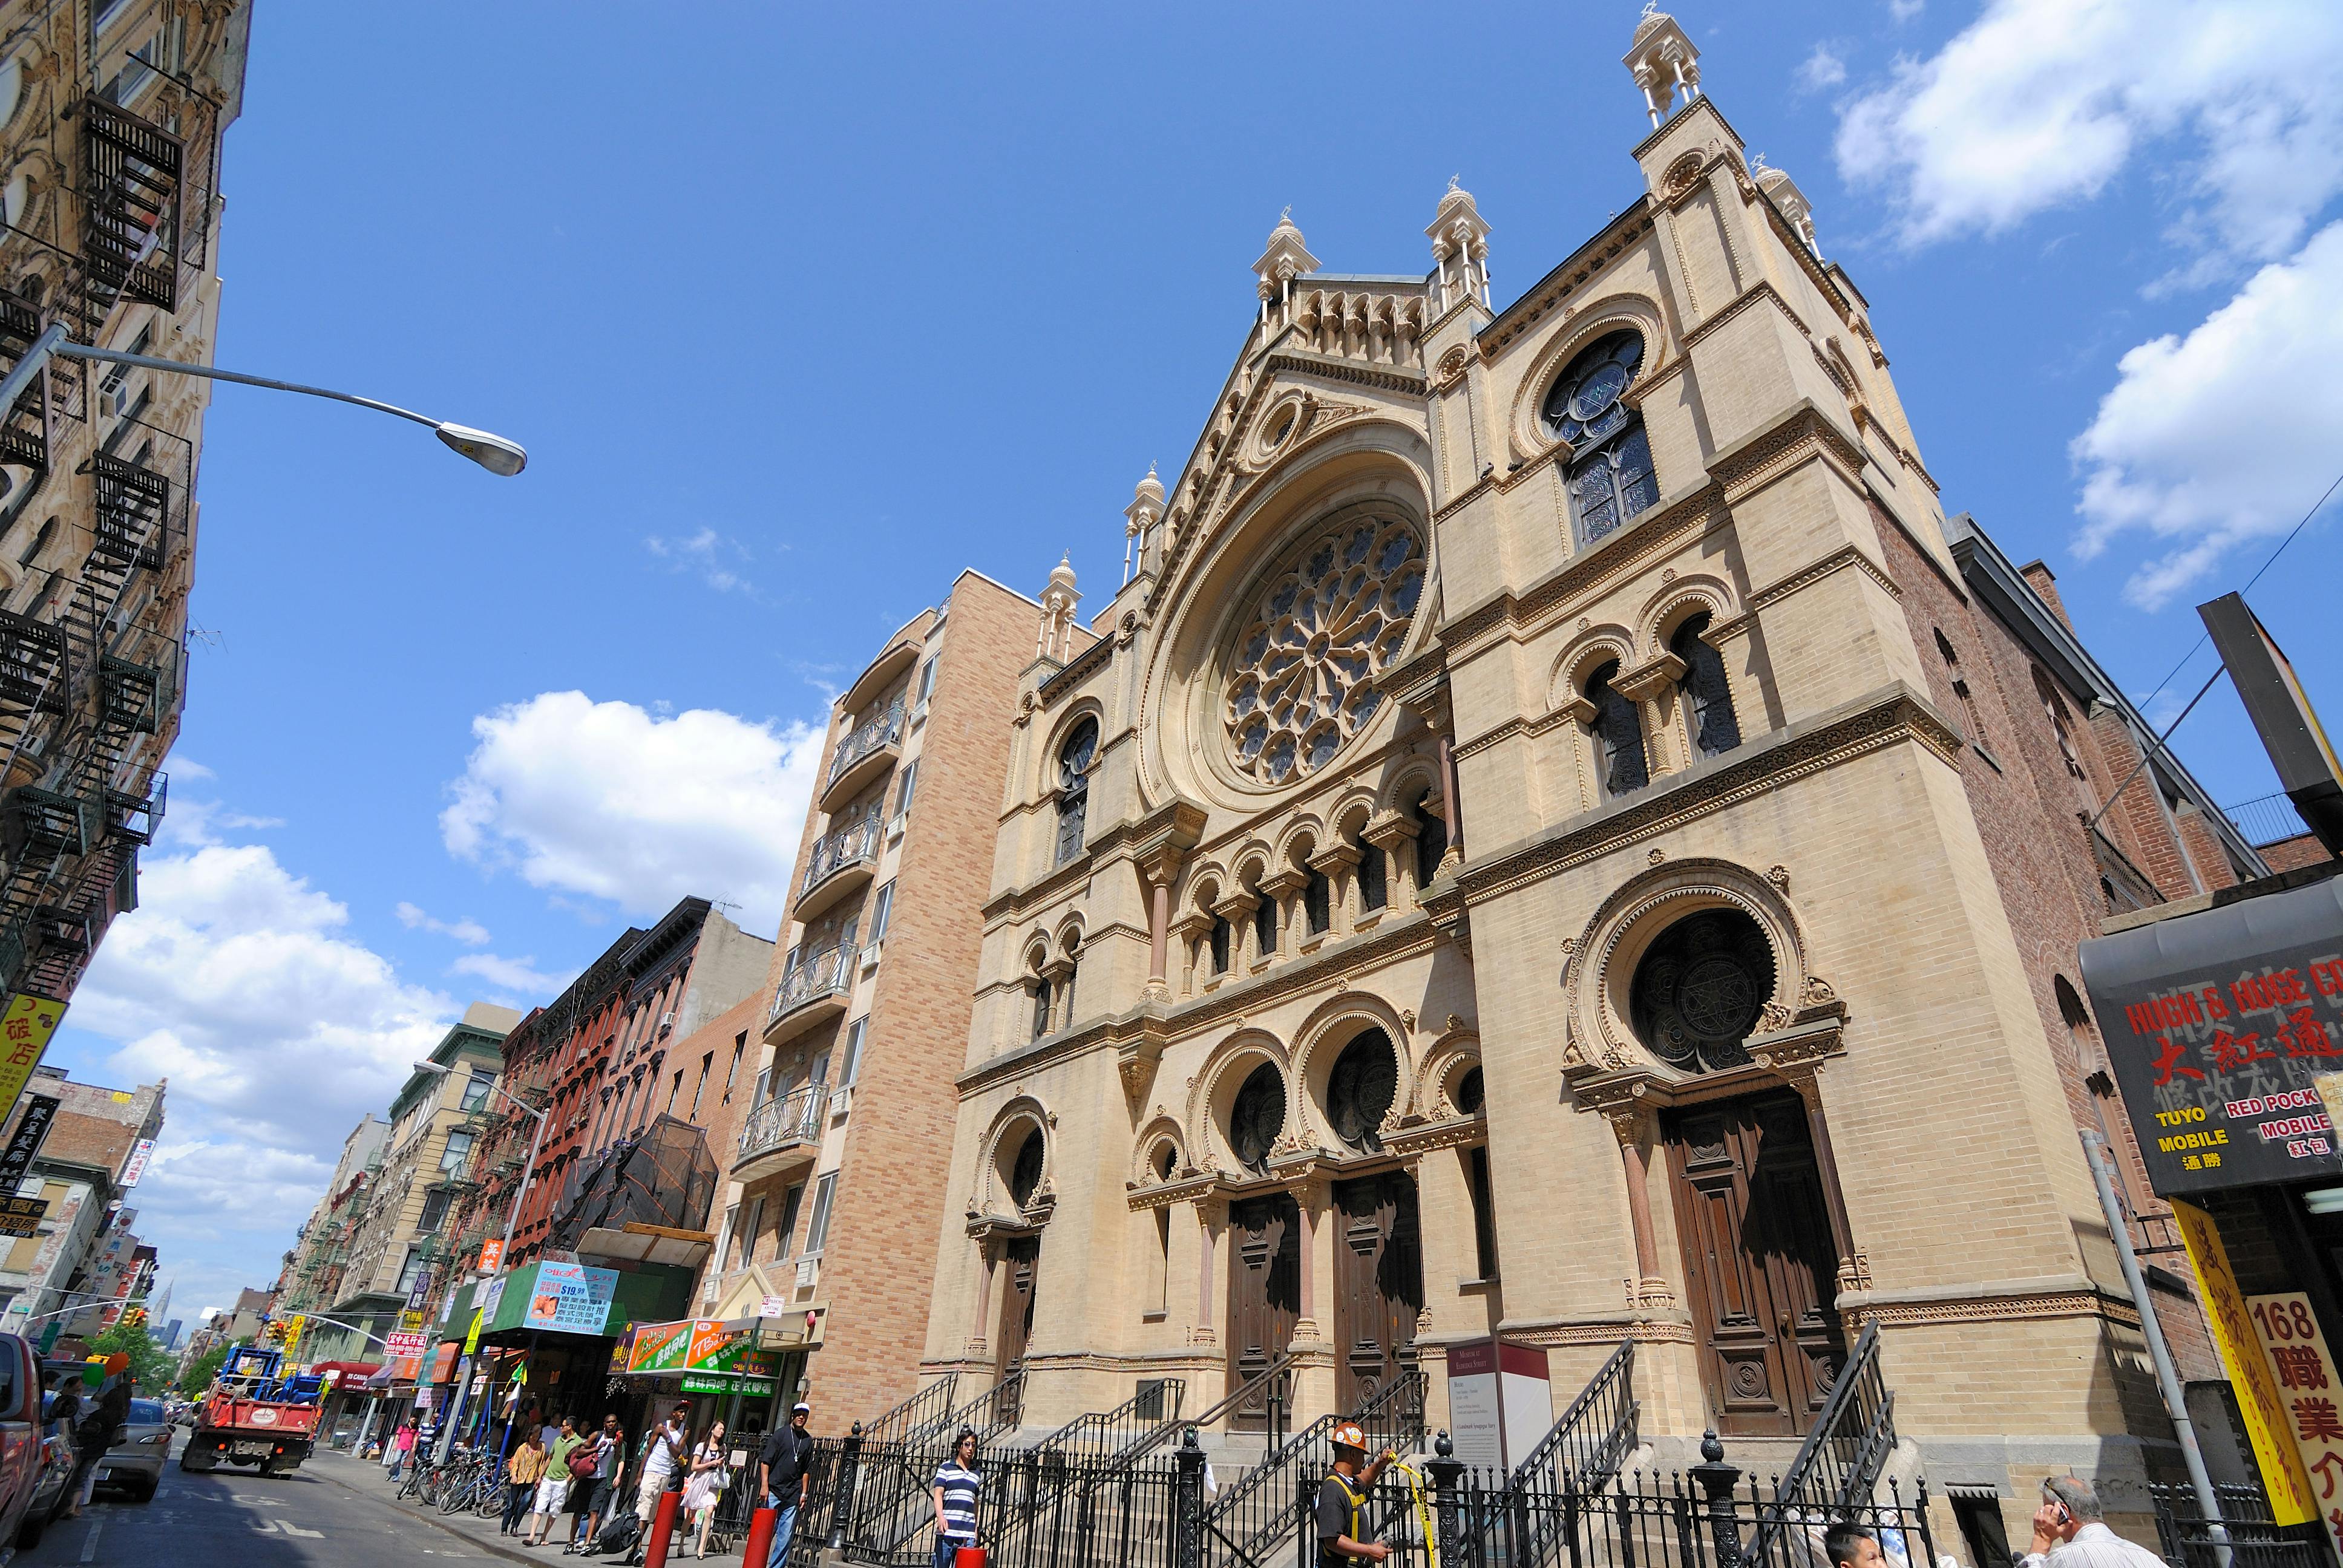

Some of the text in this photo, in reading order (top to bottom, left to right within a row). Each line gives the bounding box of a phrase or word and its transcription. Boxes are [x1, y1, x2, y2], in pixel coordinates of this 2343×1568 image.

[2125, 990, 2204, 1035] HUGH
[2200, 987, 2230, 1020] &
[2229, 969, 2311, 1014] HUGE
[2225, 1098, 2263, 1118] RED
[2266, 1089, 2319, 1112] POCK
[2155, 1106, 2207, 1128] TUYO
[2261, 1114, 2332, 1140] MOBILE
[2158, 1129, 2229, 1153] MOBILE
[2287, 1138, 2330, 1158] 紅包
[2181, 1153, 2223, 1171] 通勝
[2253, 1300, 2315, 1341] 168
